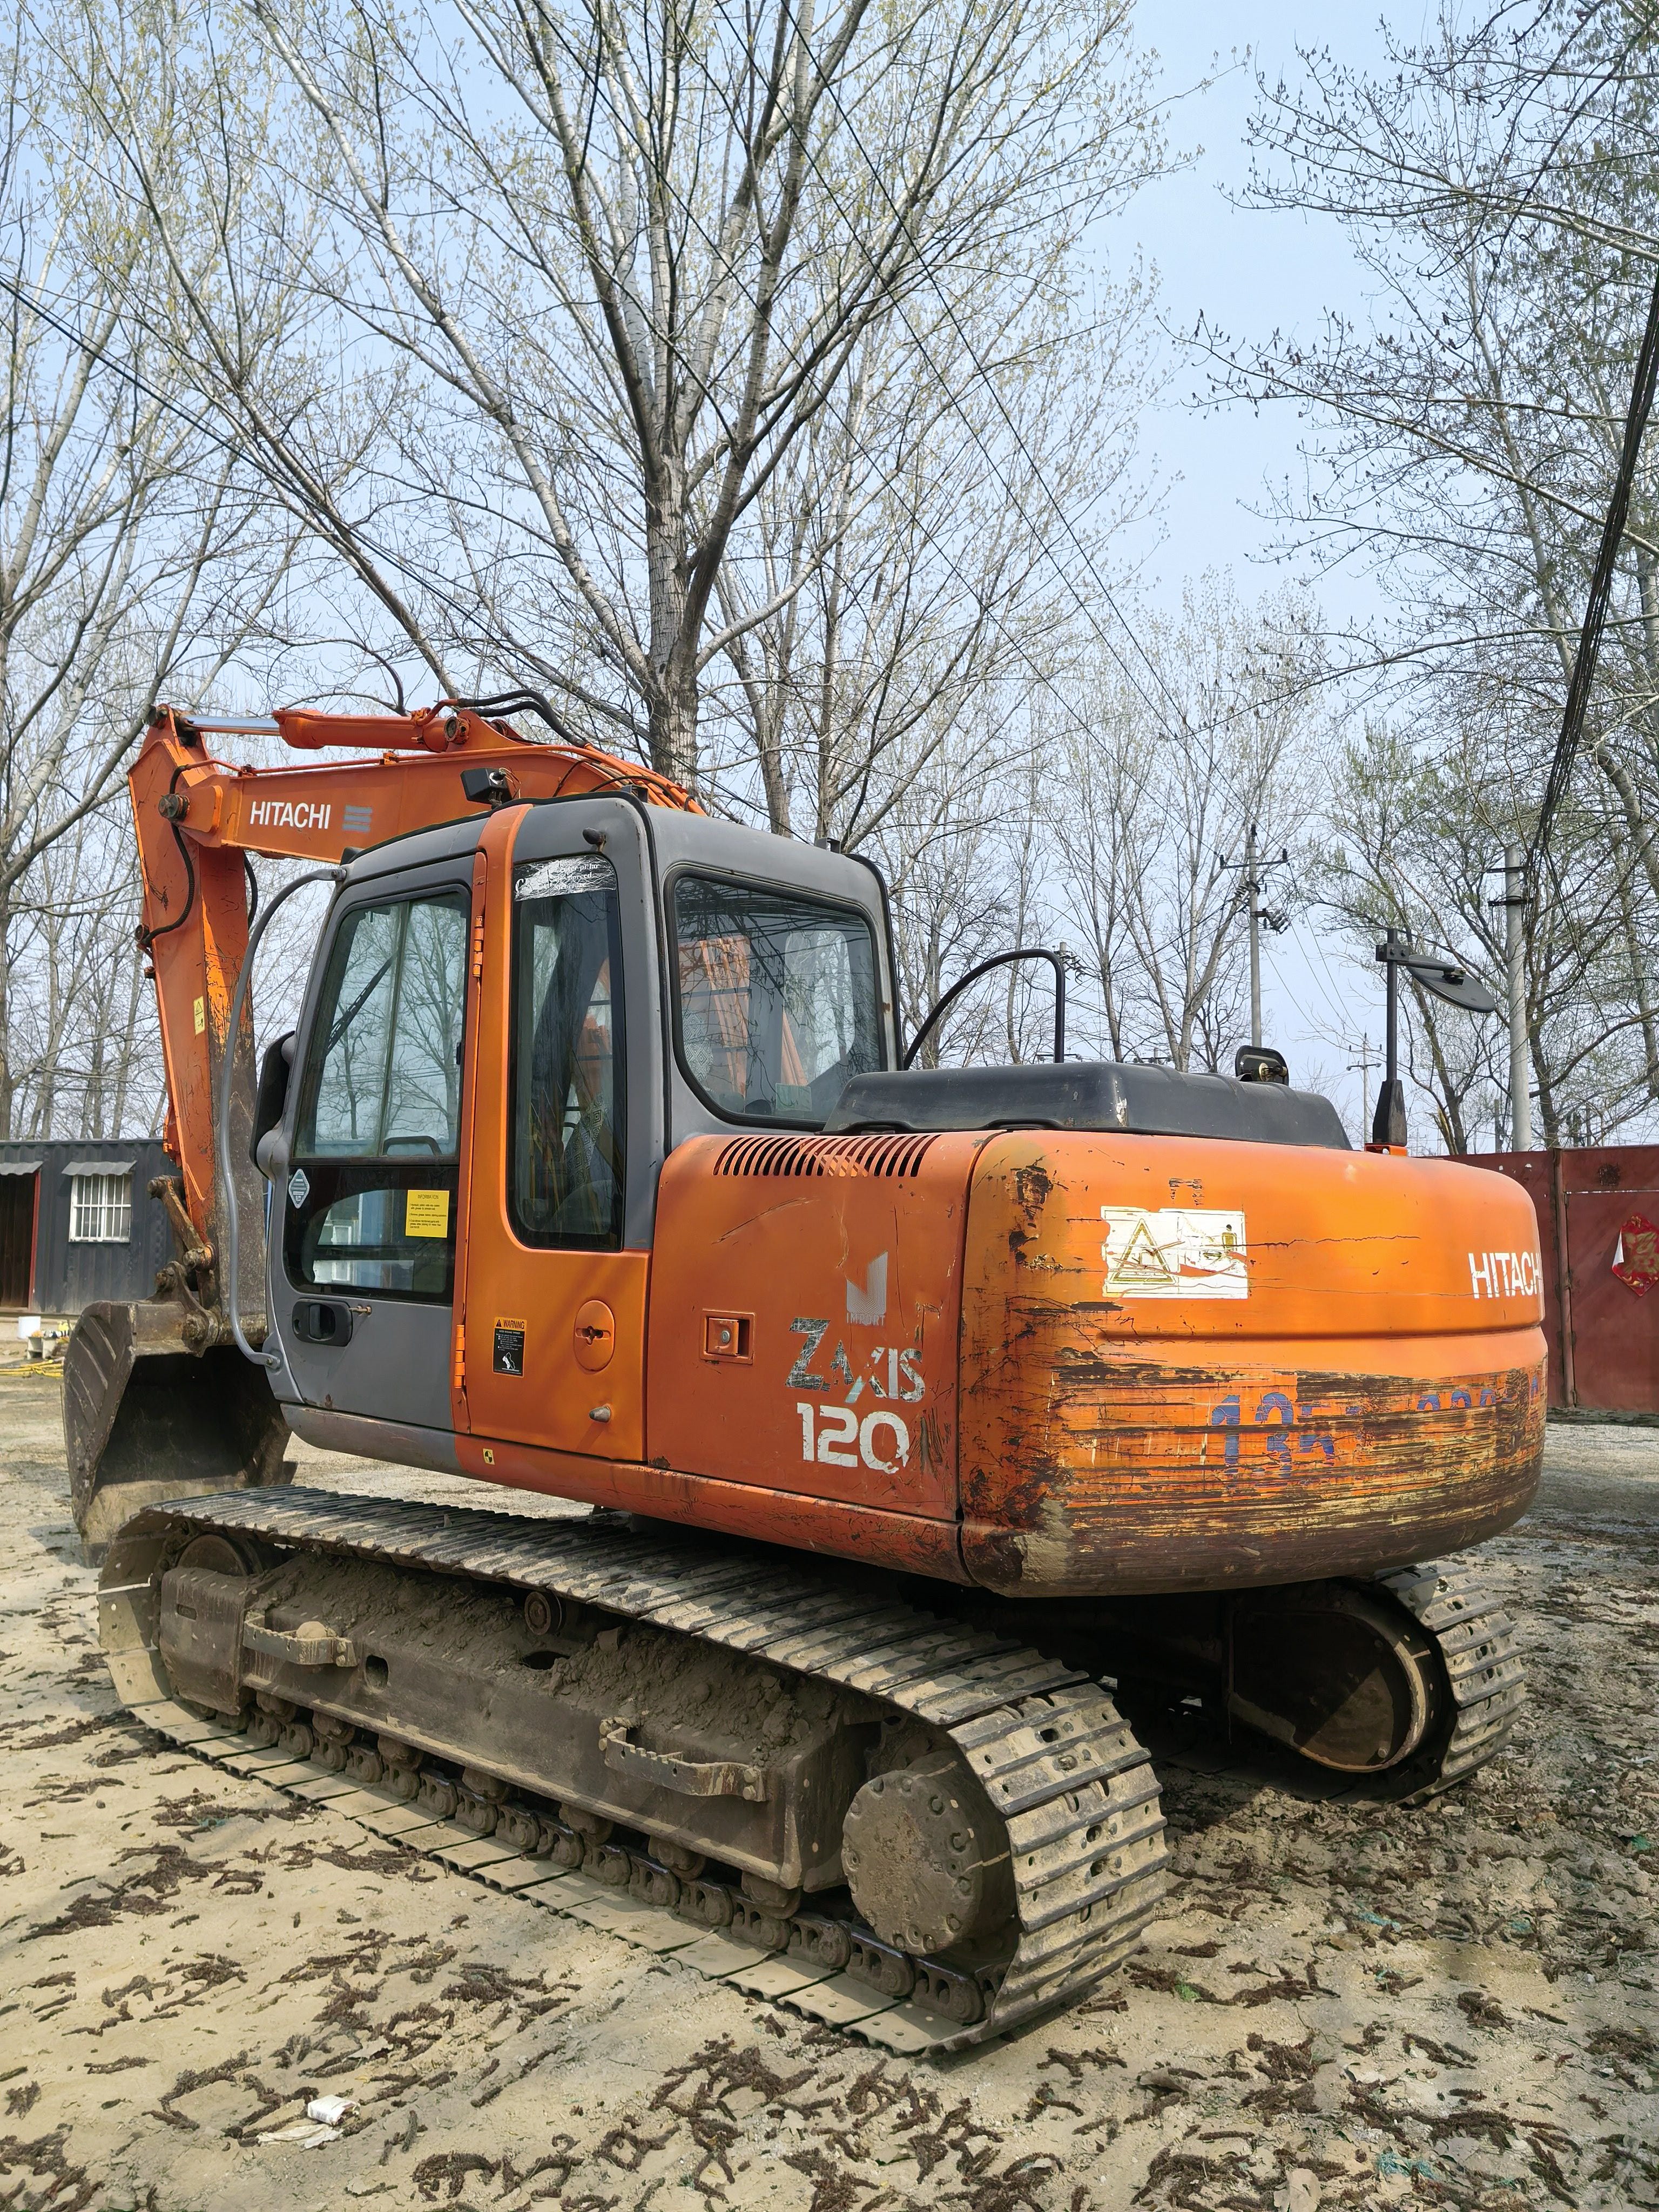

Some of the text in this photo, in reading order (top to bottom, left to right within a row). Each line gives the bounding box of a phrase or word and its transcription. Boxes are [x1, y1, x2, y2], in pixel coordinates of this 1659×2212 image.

[250, 801, 331, 829] HITACHI
[503, 1319, 525, 1329] WARNING
[797, 1402, 910, 1475] 120
